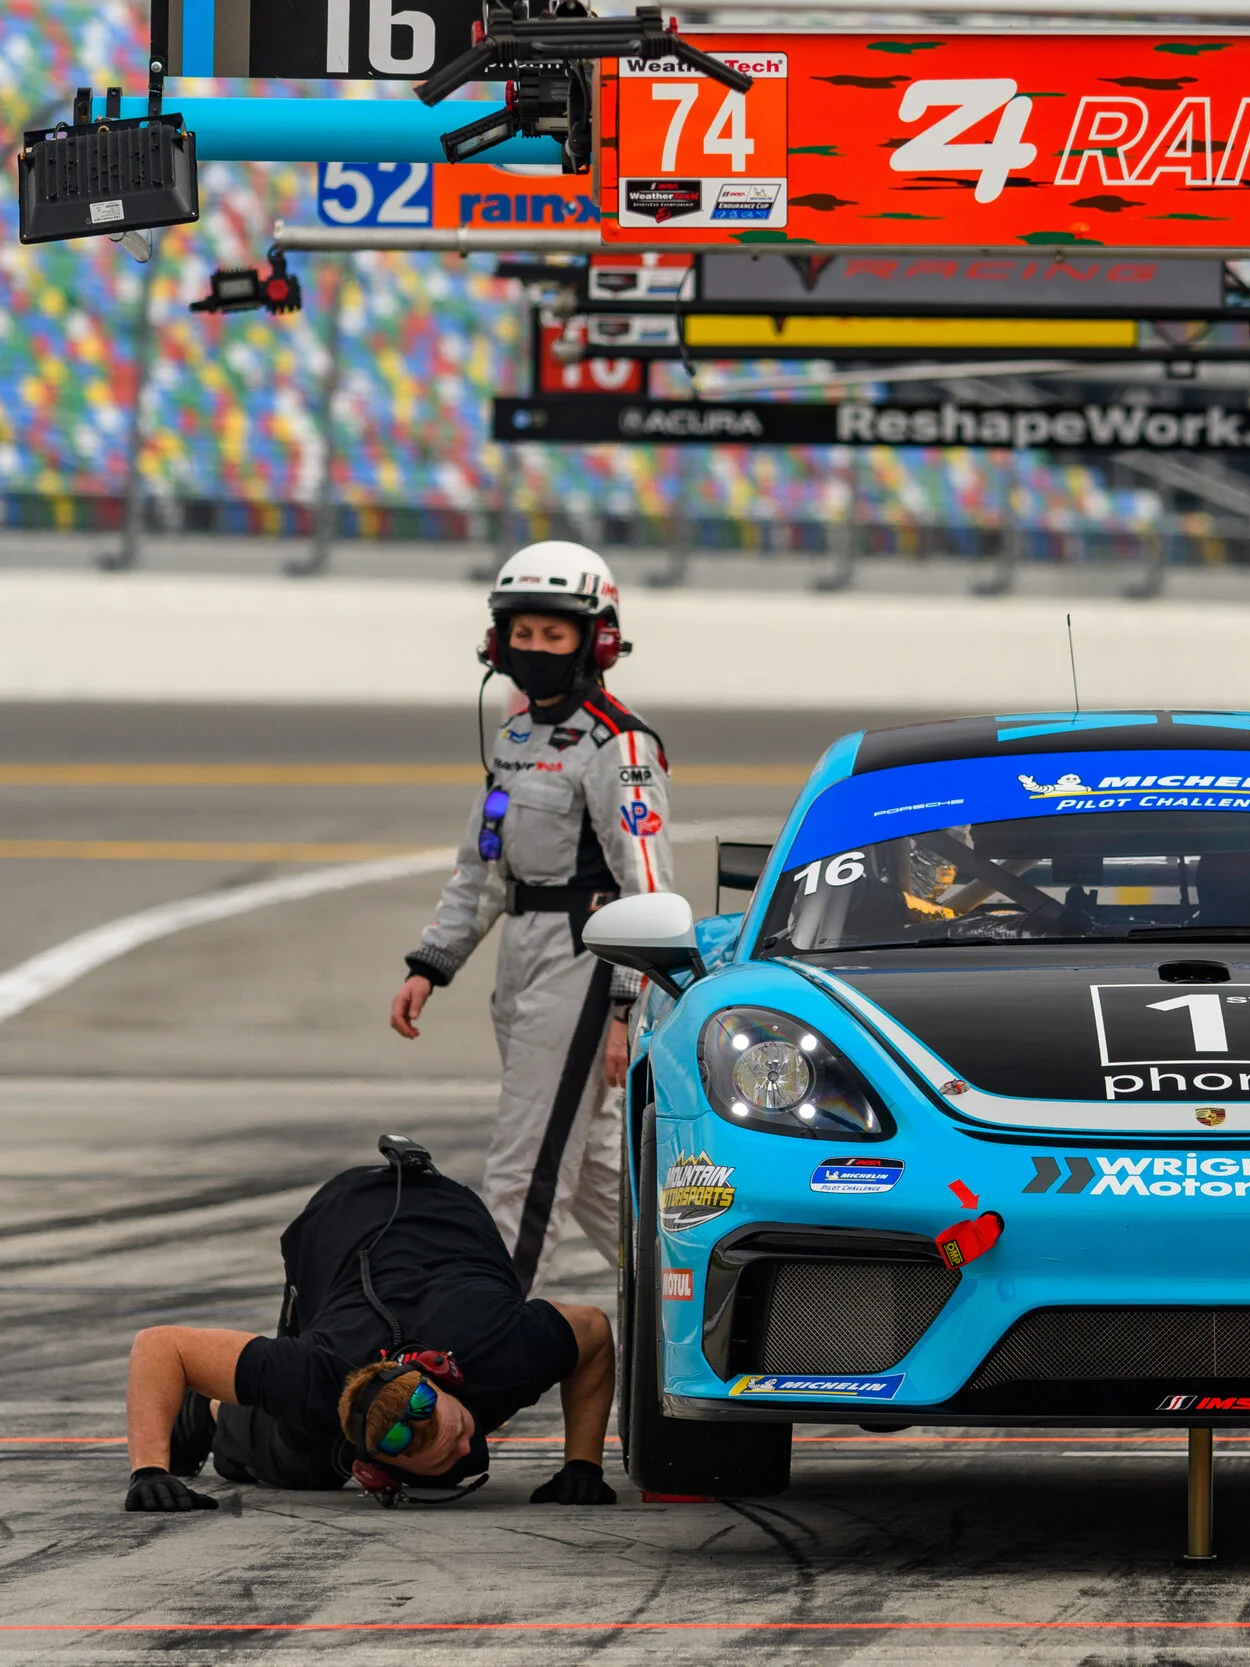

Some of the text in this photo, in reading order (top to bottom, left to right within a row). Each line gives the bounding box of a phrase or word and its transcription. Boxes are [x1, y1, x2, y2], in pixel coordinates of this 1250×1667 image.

[326, 0, 436, 75] 16
[652, 83, 755, 172] 74
[322, 162, 429, 224] 52
[843, 260, 1157, 282] RACING
[644, 409, 763, 435] ACURA
[620, 770, 652, 782] OMP
[873, 799, 964, 817] PORSCHE
[1056, 798, 1132, 810] PILOT
[620, 802, 648, 836] VP
[793, 851, 865, 896] 16
[664, 1165, 736, 1188] MOUNTAIN
[946, 1242, 961, 1264] OMP
[662, 1273, 691, 1296] MOTUL
[779, 1381, 887, 1392] MICHELIN
